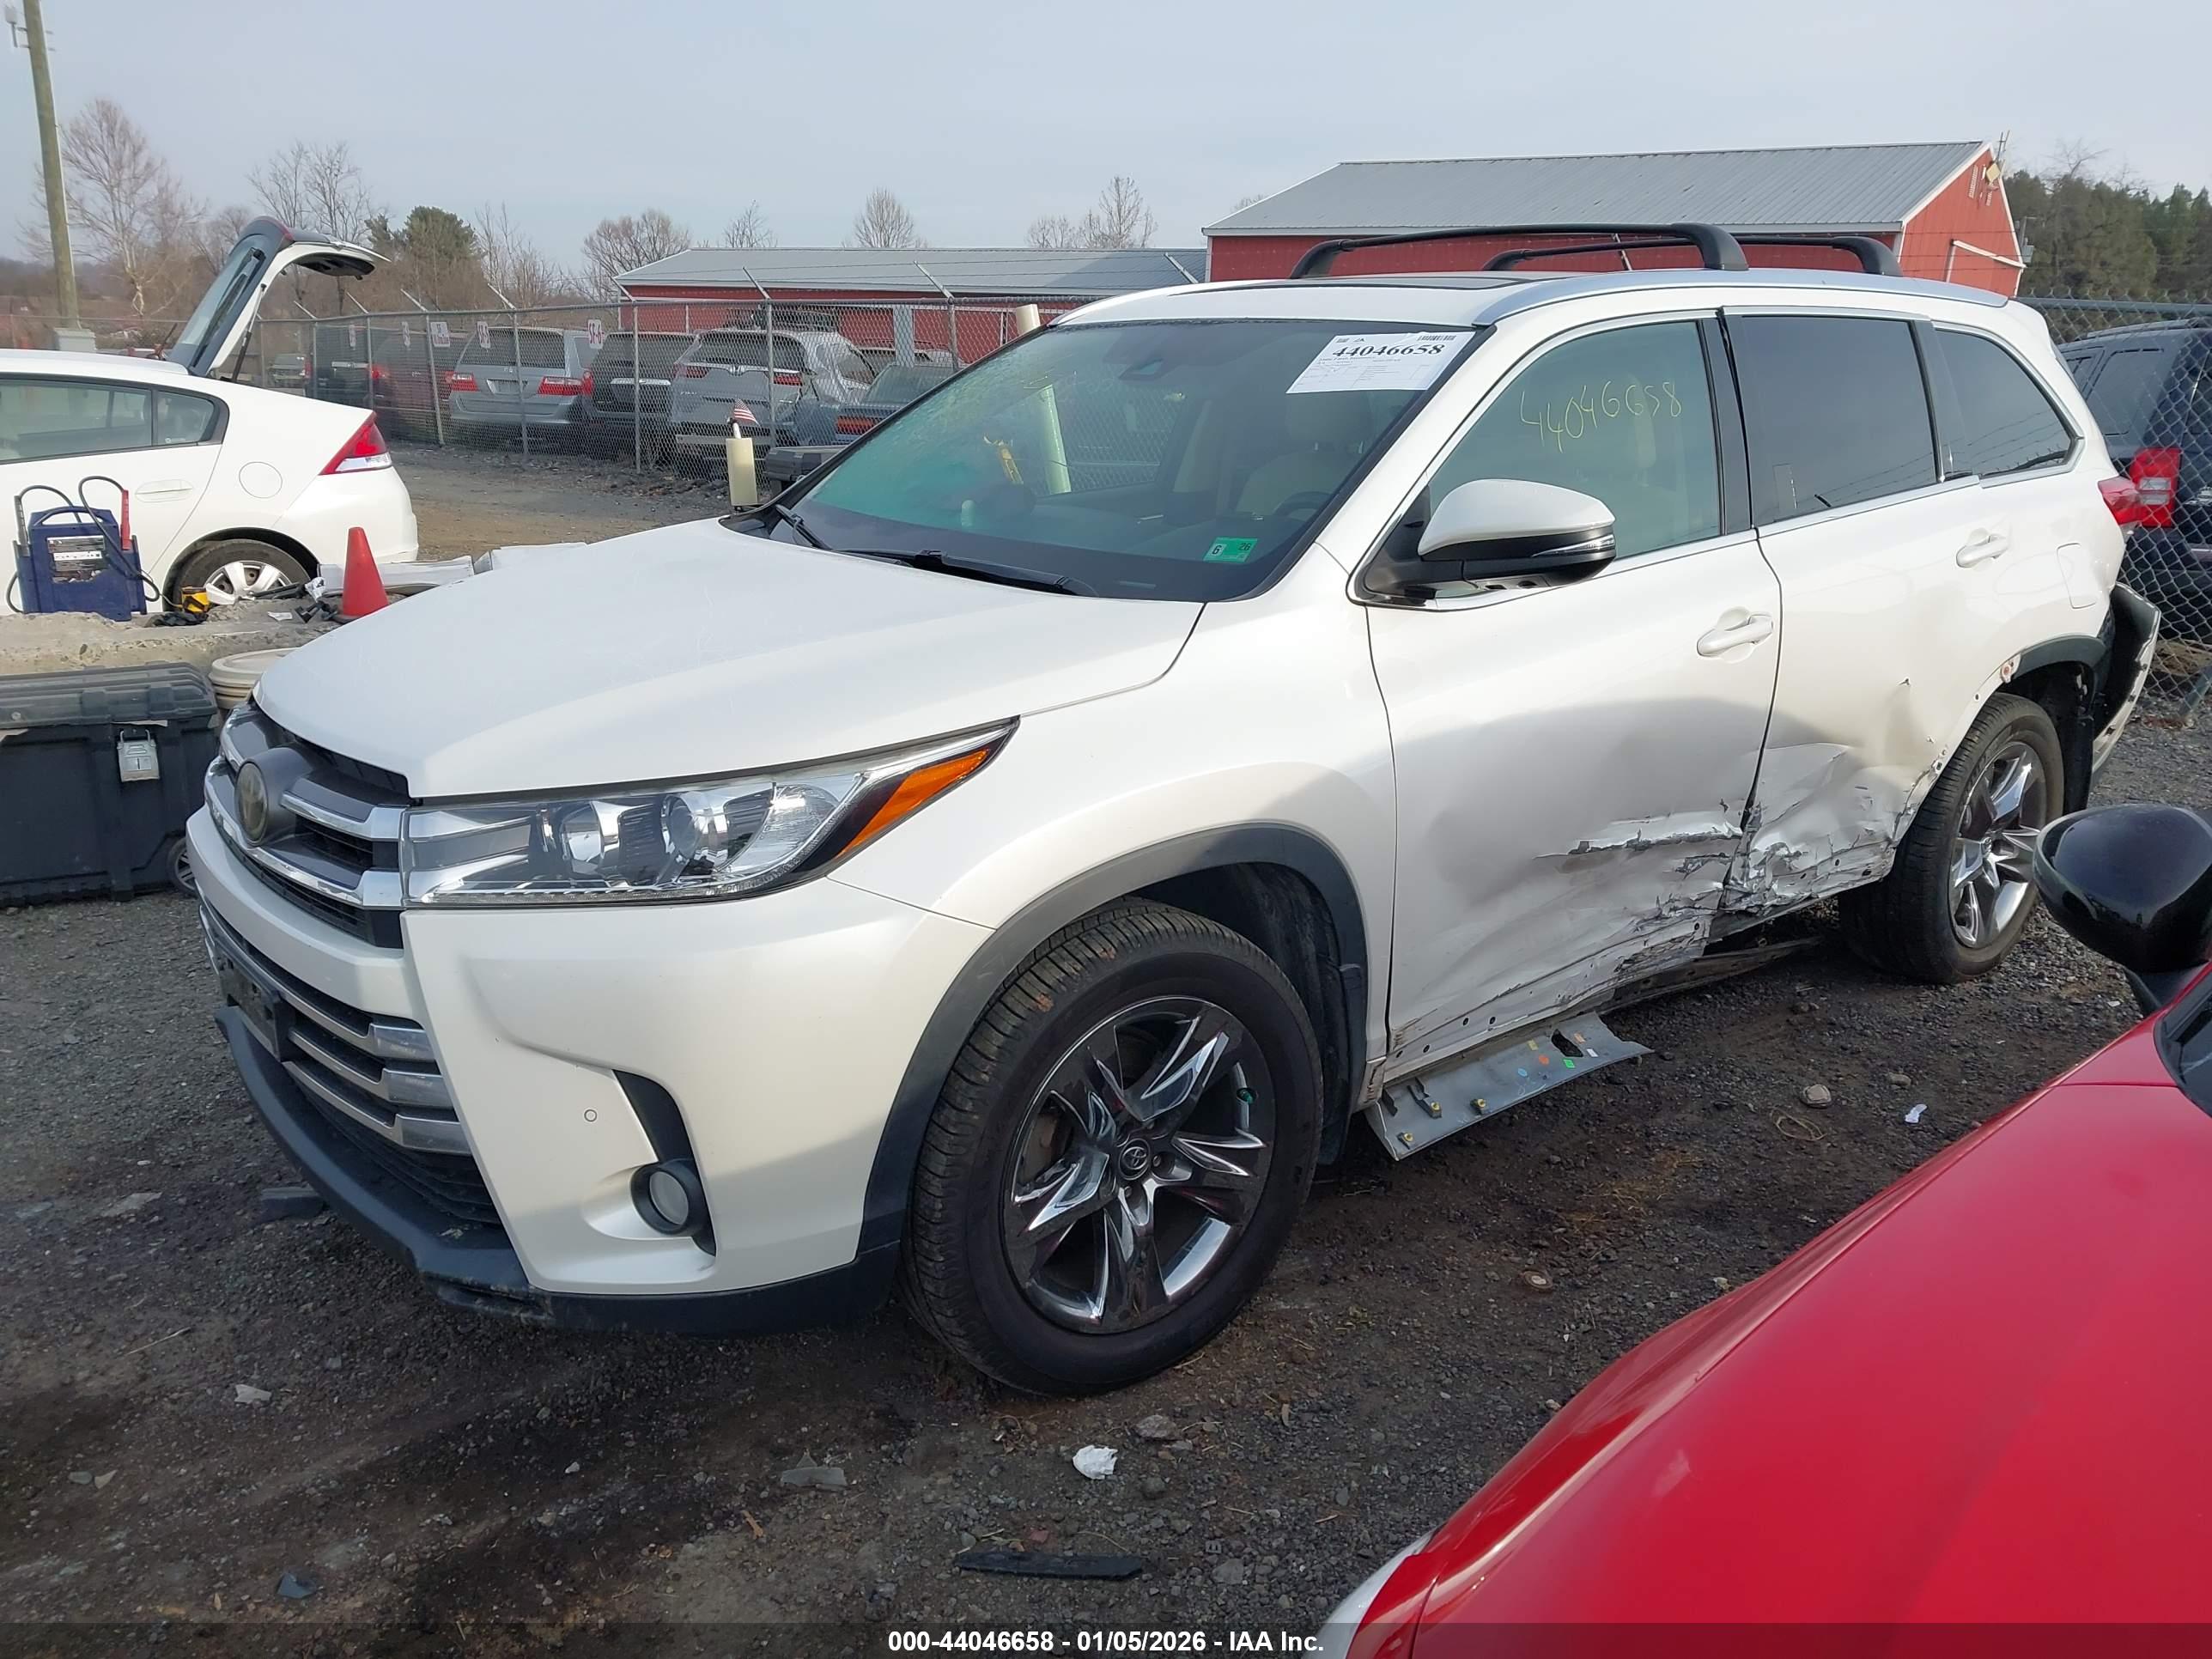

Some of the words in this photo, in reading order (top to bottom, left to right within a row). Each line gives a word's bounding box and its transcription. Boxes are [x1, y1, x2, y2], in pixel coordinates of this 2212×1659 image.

[1333, 343, 1445, 357] 44046658
[1520, 380, 1682, 453] 44046658
[1212, 544, 1222, 555] 6
[1238, 542, 1252, 551] 26
